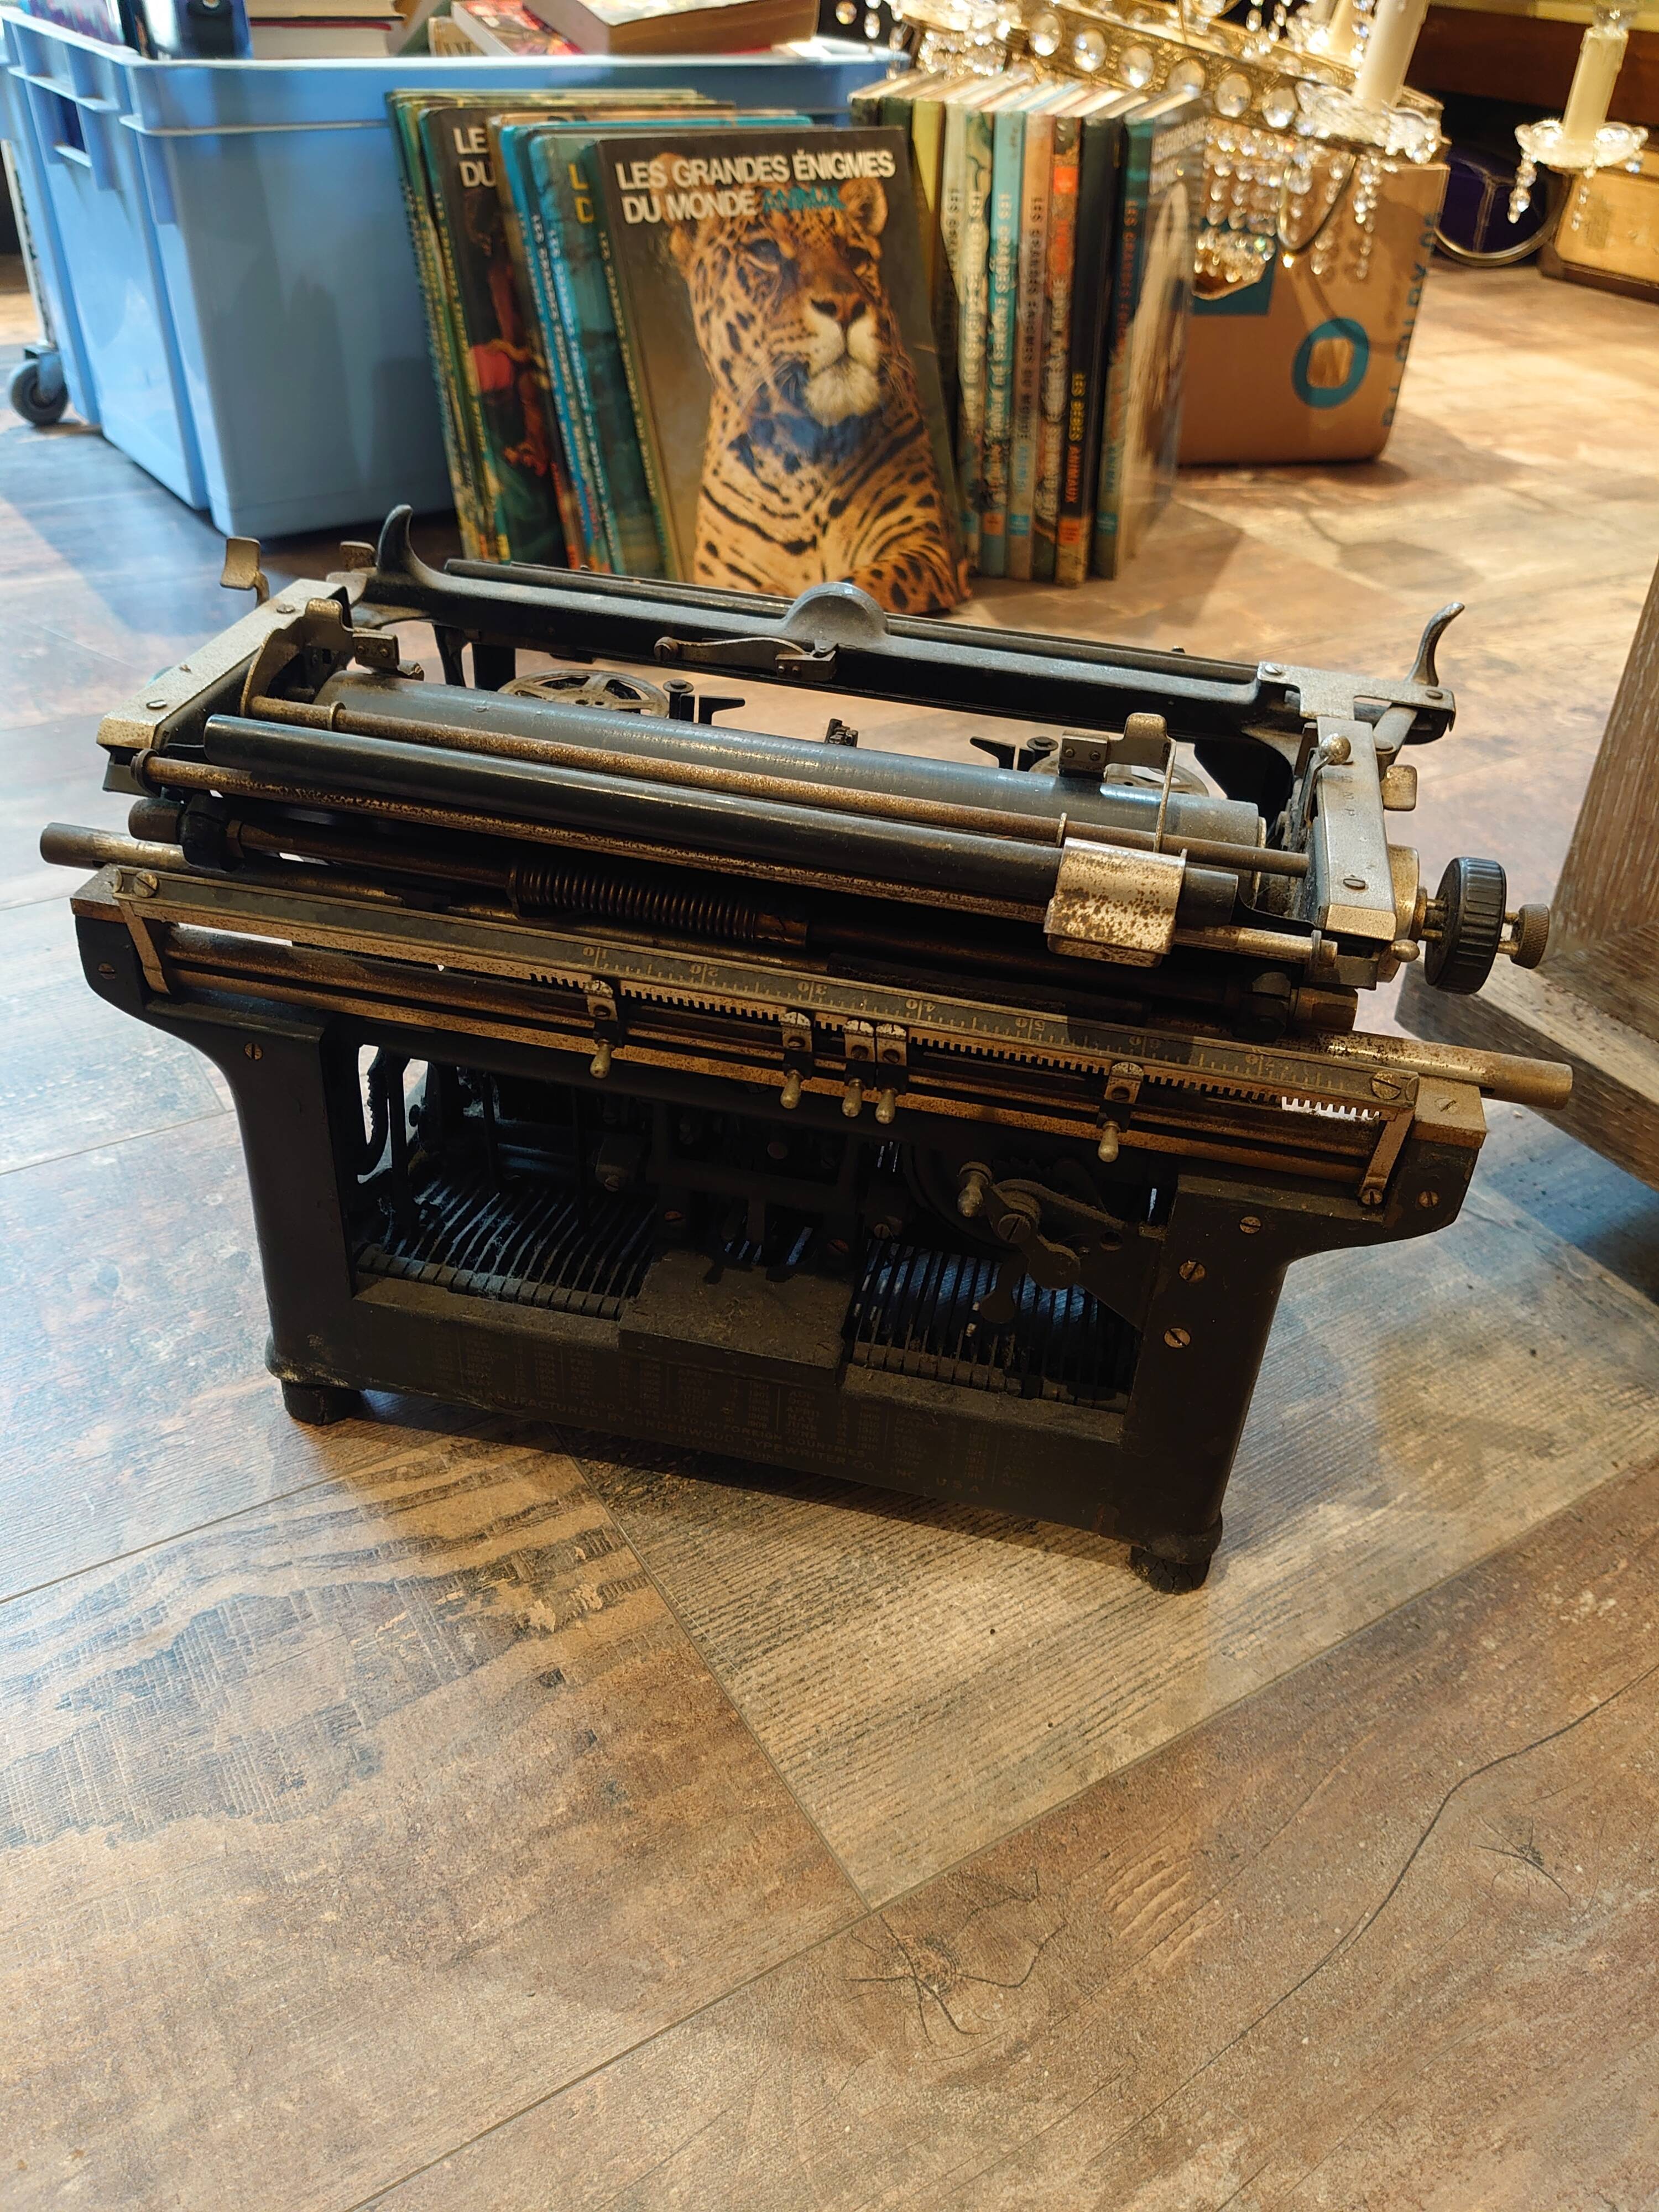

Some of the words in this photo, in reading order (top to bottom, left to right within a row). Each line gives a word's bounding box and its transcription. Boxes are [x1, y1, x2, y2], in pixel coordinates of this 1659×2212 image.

[460, 161, 496, 187] DU
[615, 161, 667, 190] LES
[671, 153, 790, 187] GRANDES
[791, 148, 896, 181] ÉNIGMES
[622, 196, 662, 225] DU
[666, 190, 760, 221] MONDE
[997, 192, 1011, 220] LES
[1030, 197, 1044, 222] LES
[1123, 200, 1138, 226] LES
[531, 214, 545, 244] LES
[598, 231, 611, 261] LES
[994, 225, 1011, 293] GRANDES
[1065, 444, 1082, 504] ANIMAUX
[582, 1397, 615, 1411] ALSO
[703, 1419, 717, 1429] IN
[723, 1423, 781, 1442] FOREIGN
[787, 1436, 864, 1458] COUNTRIES
[784, 1427, 817, 1439] JUNE
[785, 1420, 817, 1432] JUNE
[787, 1412, 815, 1424] MAY
[608, 1411, 627, 1424] BY
[634, 1415, 734, 1443] UNDERWOOD
[742, 1437, 846, 1465] TYPEWRITER
